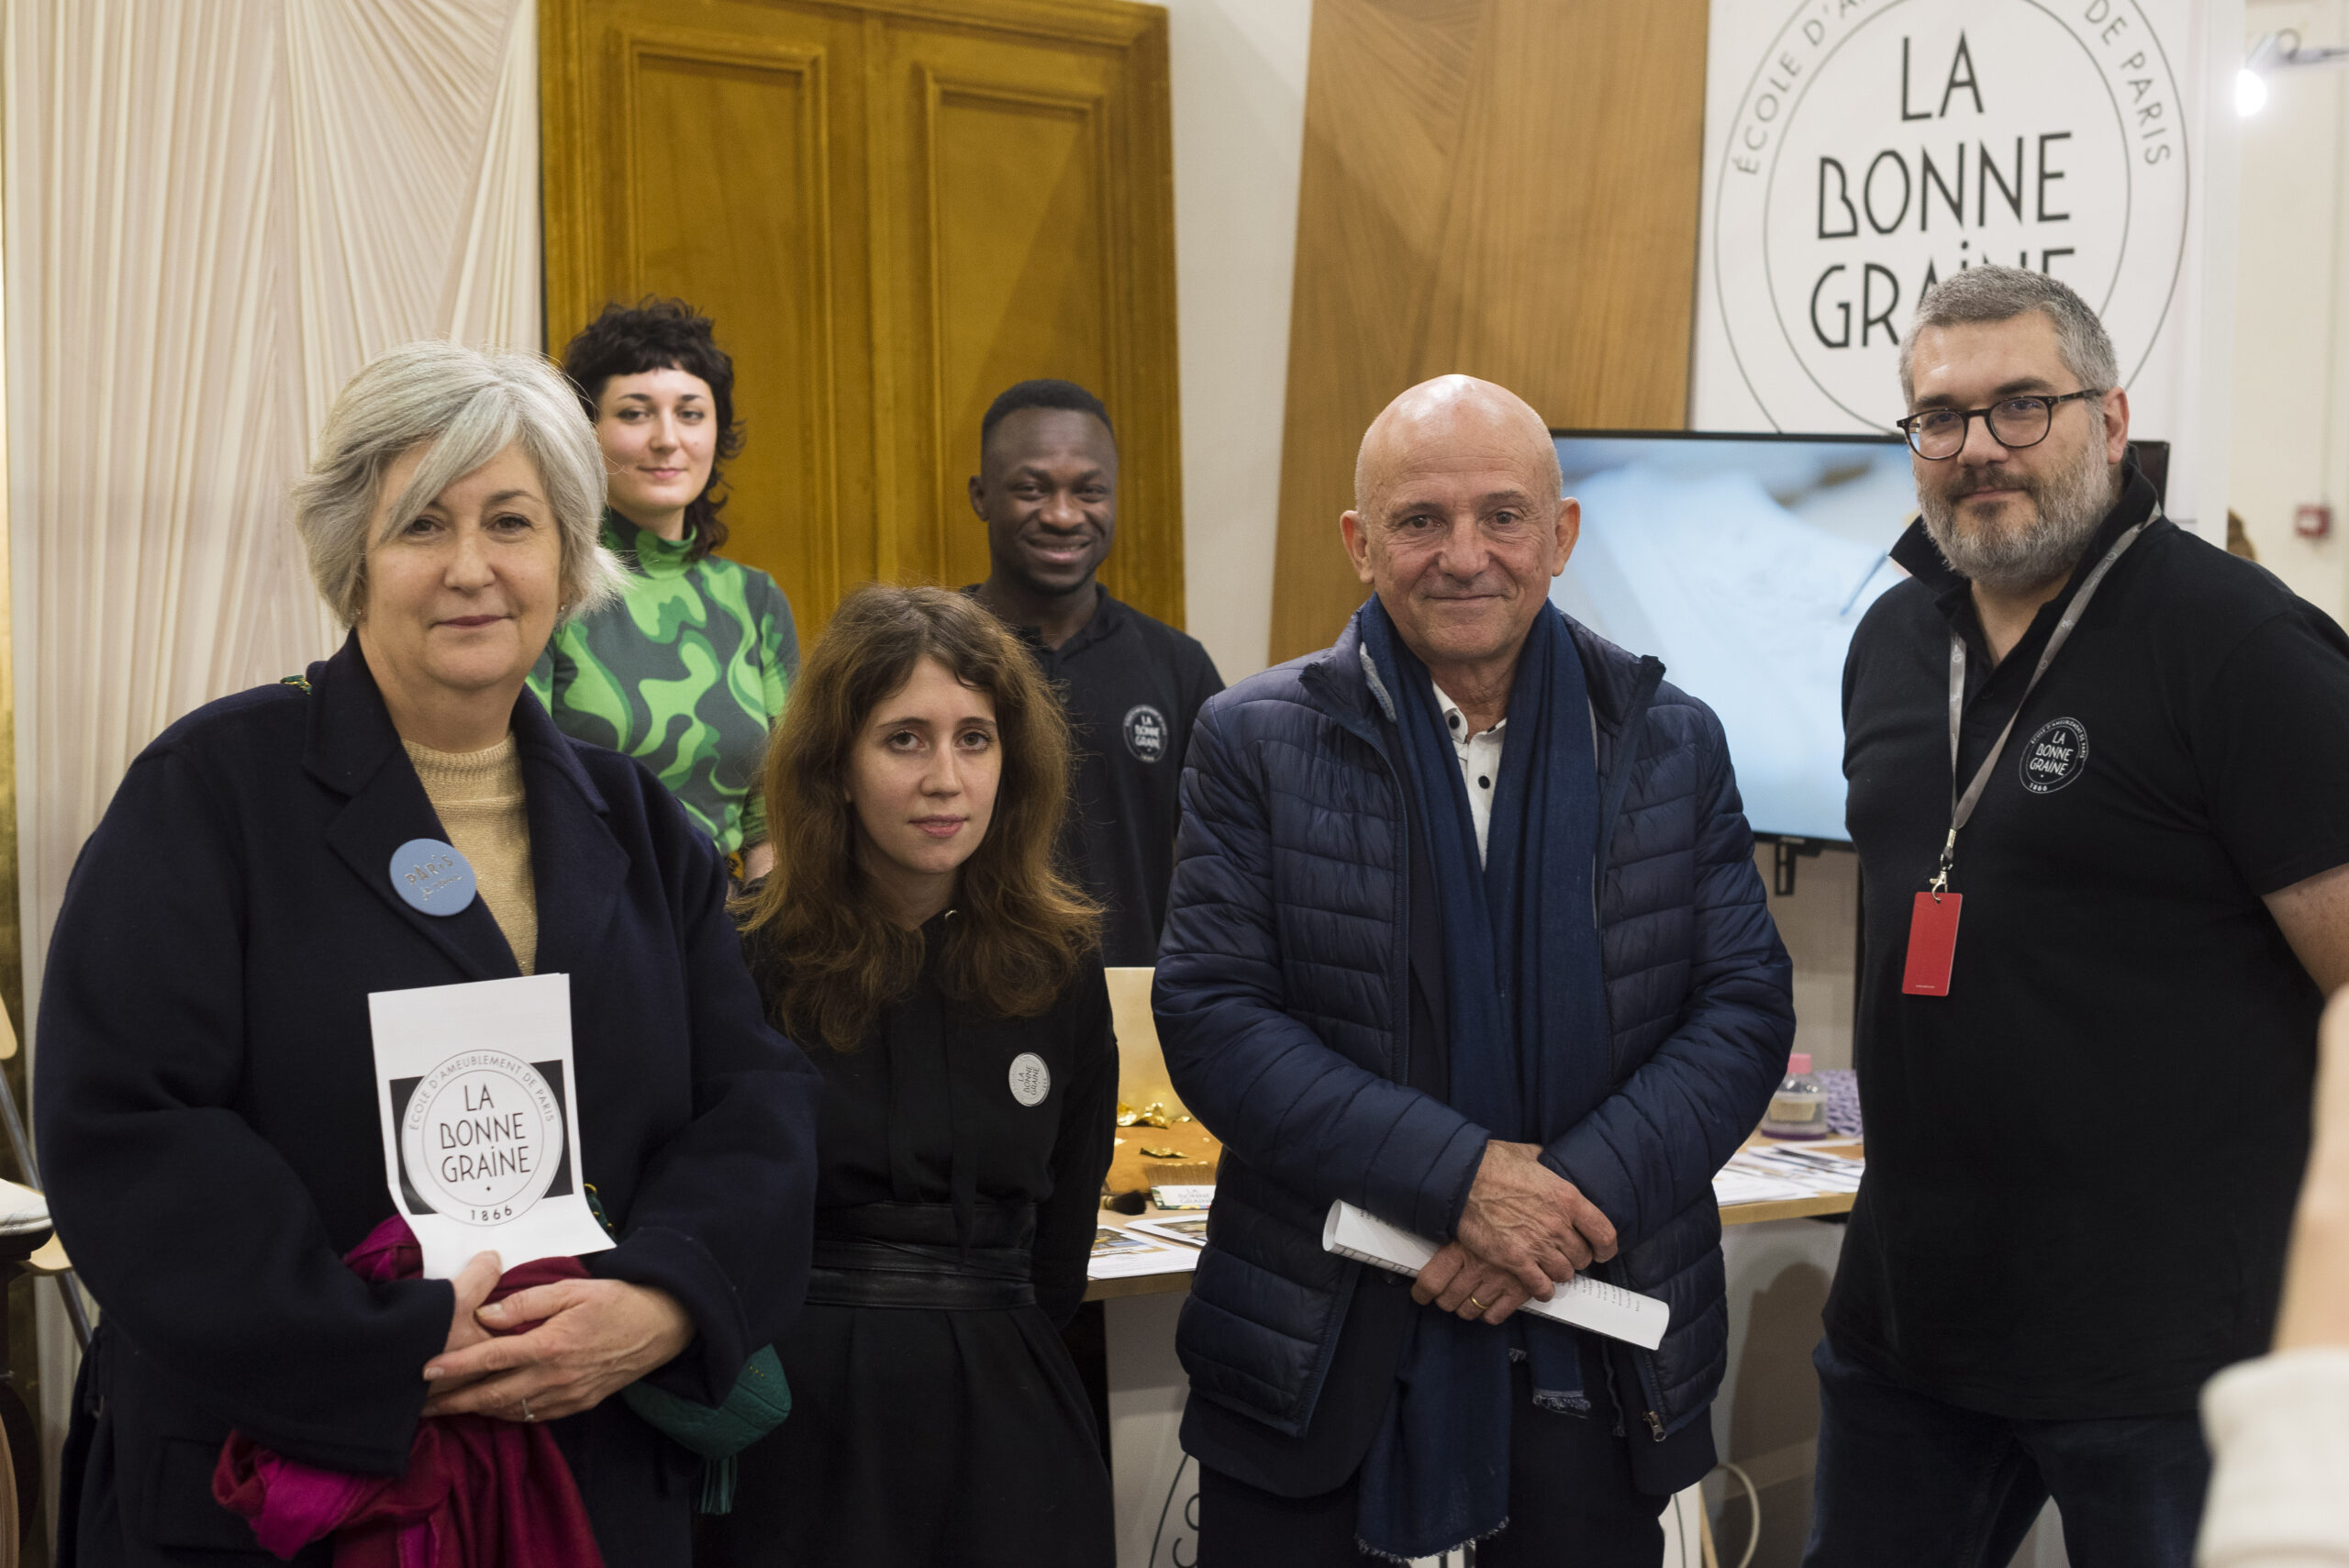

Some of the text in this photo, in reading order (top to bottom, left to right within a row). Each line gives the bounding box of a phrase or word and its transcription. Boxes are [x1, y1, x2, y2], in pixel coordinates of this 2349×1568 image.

[1731, 51, 1802, 175] ÉCOLE
[2085, 0, 2128, 46] DE
[2121, 50, 2171, 165] PARIS
[1900, 28, 1985, 122] LA
[1818, 131, 2072, 239] BONNE
[2035, 743, 2074, 762] BONNE
[2052, 730, 2066, 745] LA
[408, 1055, 555, 1130] ÉCOLE D'AMEUBLEMENT DE PARIS
[464, 1083, 495, 1112] LA
[440, 1112, 527, 1149] BONNE
[470, 1206, 513, 1221] 1866
